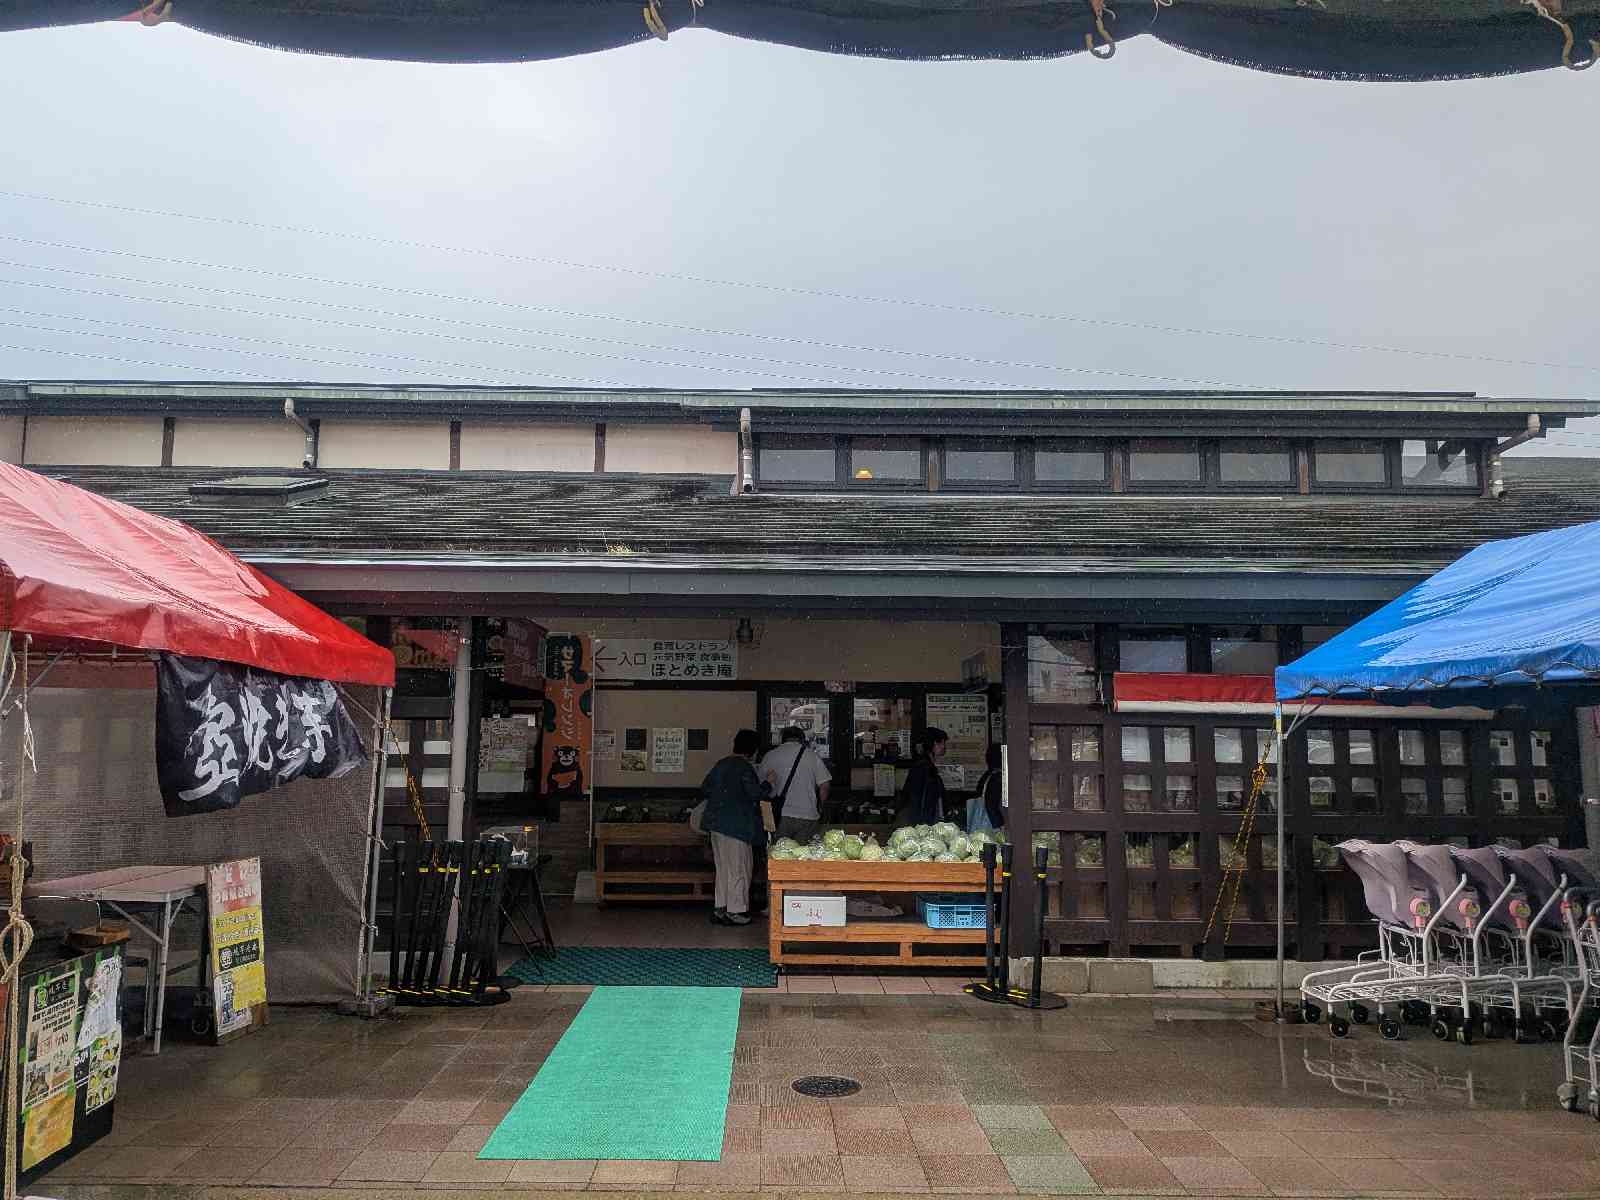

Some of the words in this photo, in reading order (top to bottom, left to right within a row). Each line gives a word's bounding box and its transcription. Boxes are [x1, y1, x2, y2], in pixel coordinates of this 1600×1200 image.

[618, 652, 647, 667] 入口
[651, 664, 733, 677] ほとめき庵
